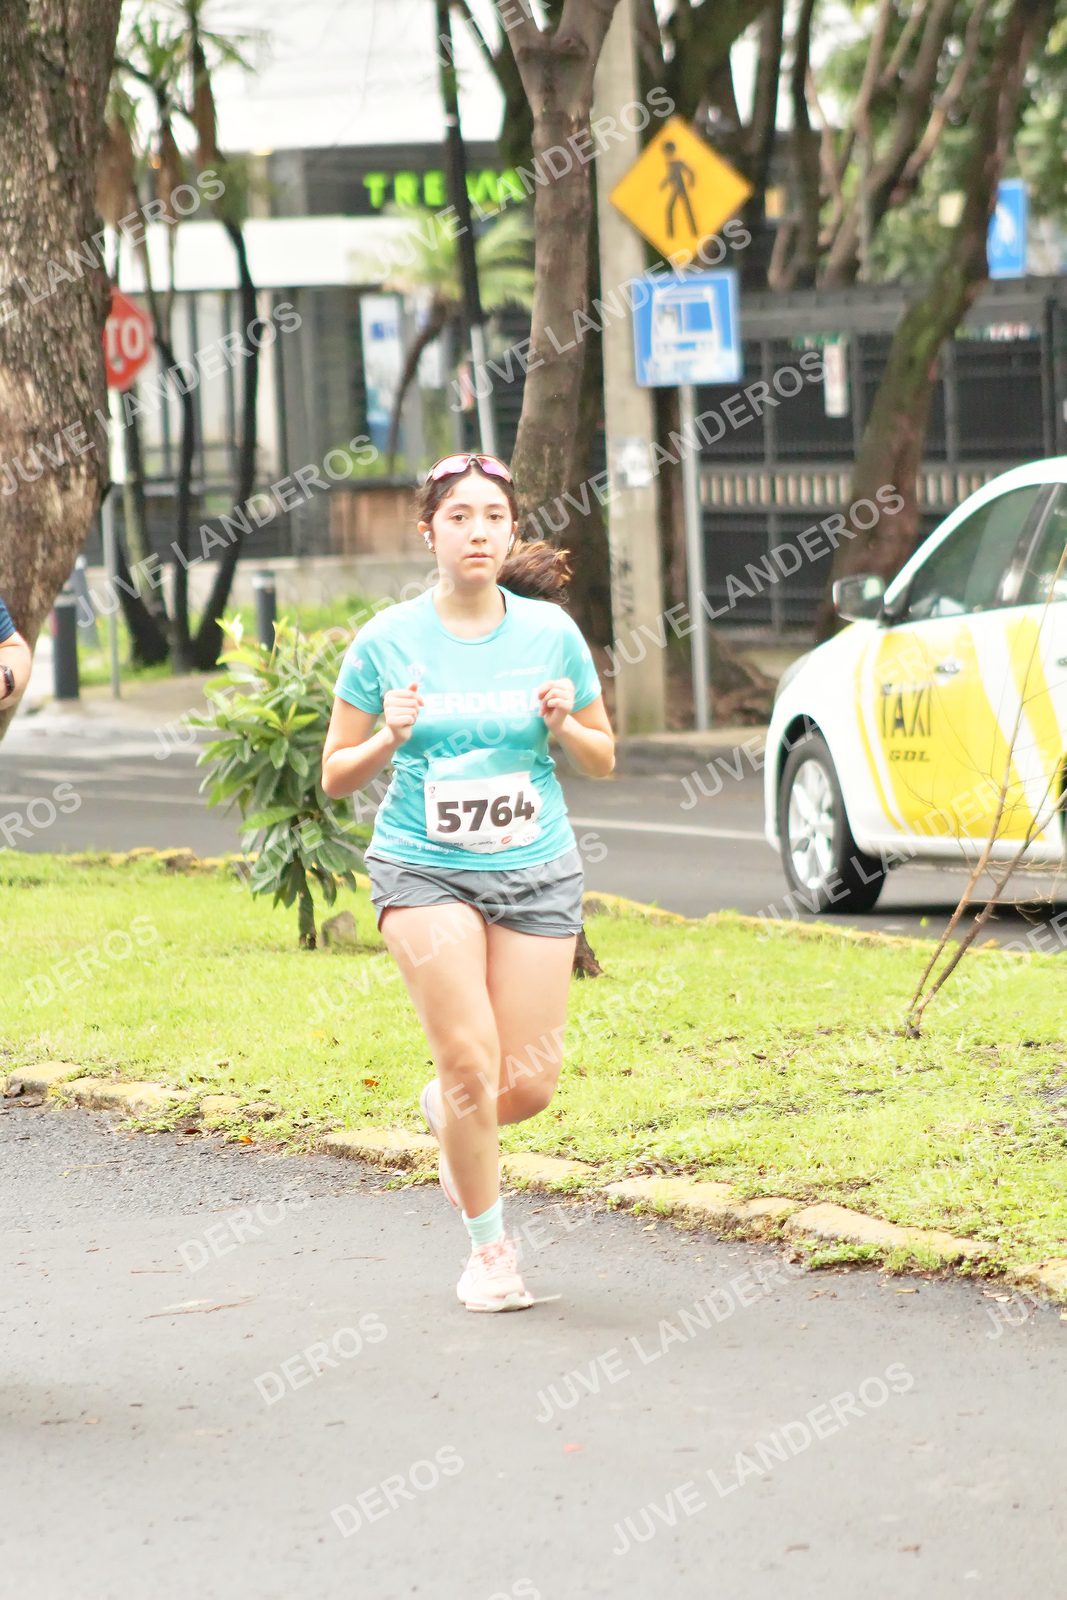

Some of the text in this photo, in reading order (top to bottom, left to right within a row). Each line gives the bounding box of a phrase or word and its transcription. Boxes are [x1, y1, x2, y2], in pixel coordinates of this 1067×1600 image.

[881, 683, 932, 738] TAXI
[889, 750, 931, 762] GDL
[436, 791, 535, 834] 5764
